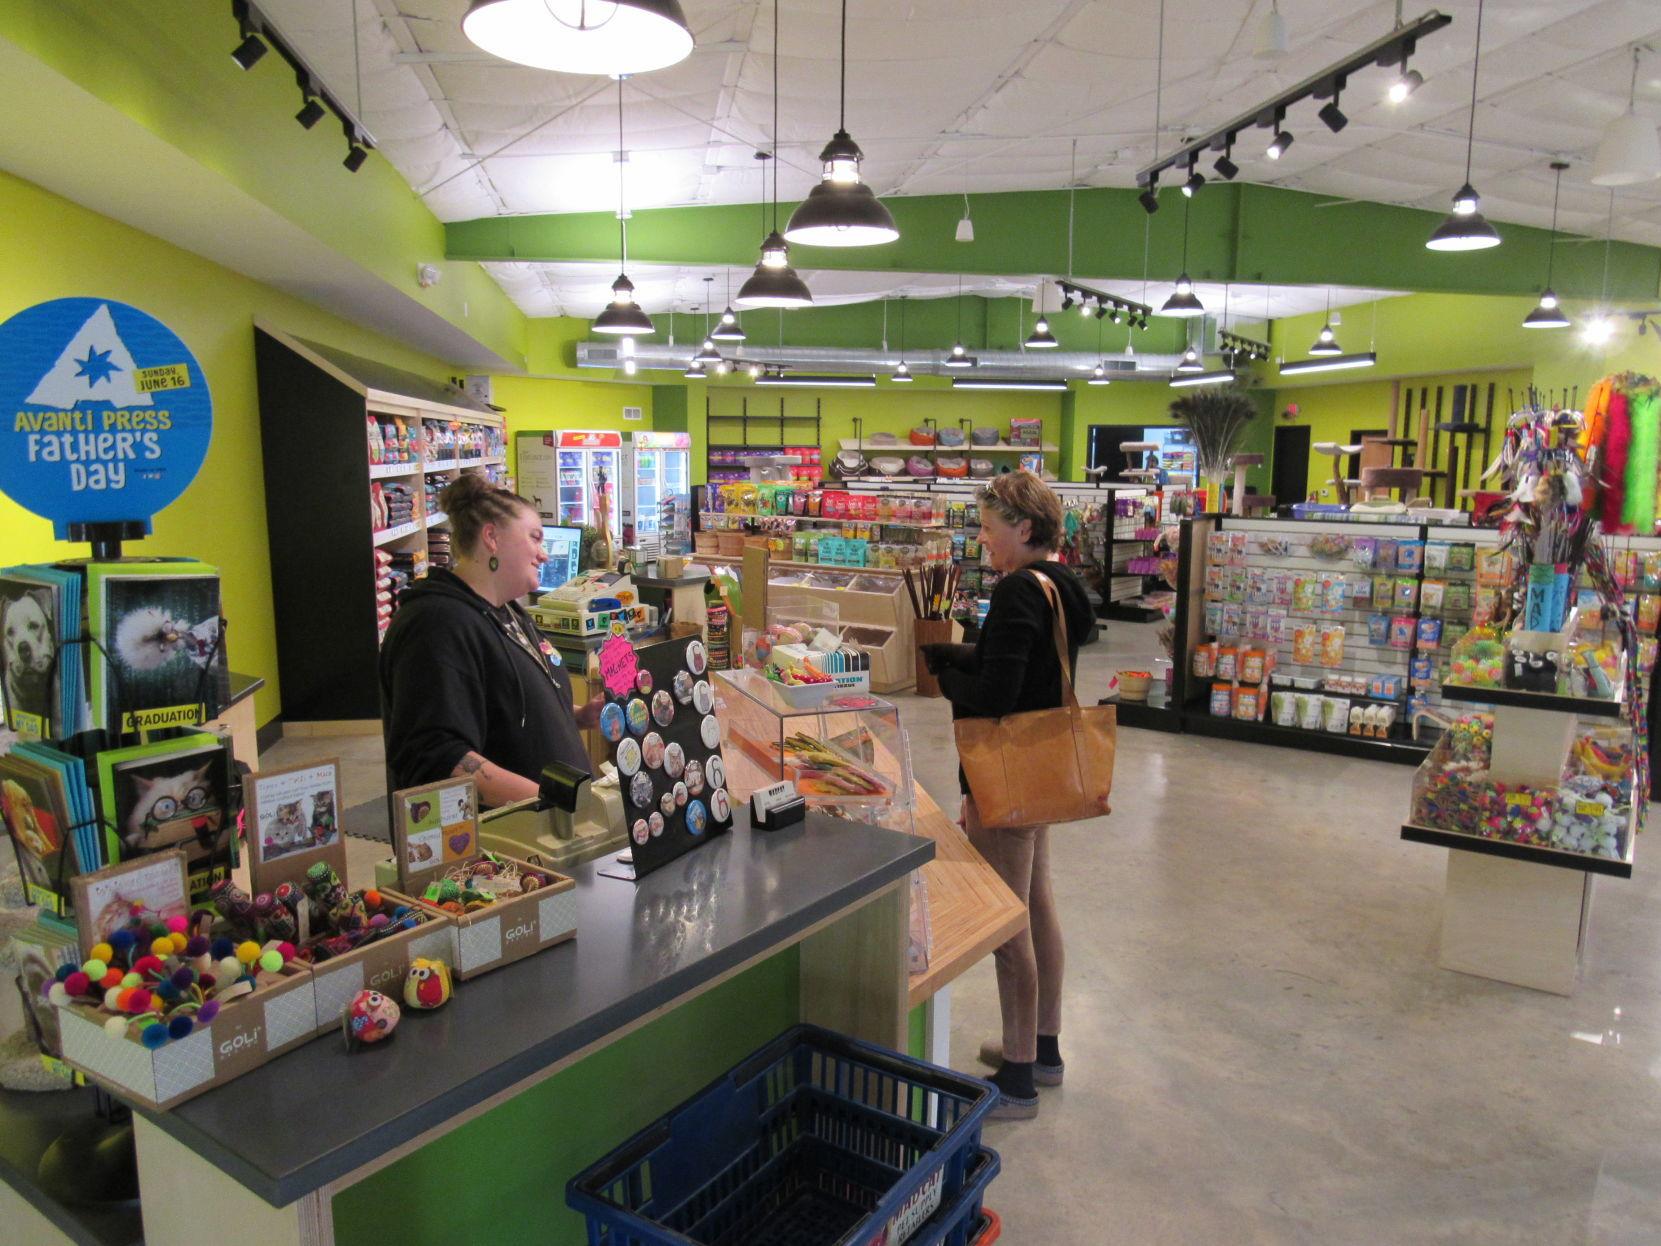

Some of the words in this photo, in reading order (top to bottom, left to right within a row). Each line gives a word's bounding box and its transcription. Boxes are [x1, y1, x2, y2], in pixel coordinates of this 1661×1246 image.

[171, 375, 185, 387] 16
[71, 462, 126, 491] Day
[505, 923, 536, 941] GOLI
[220, 1027, 258, 1054] GOLI
